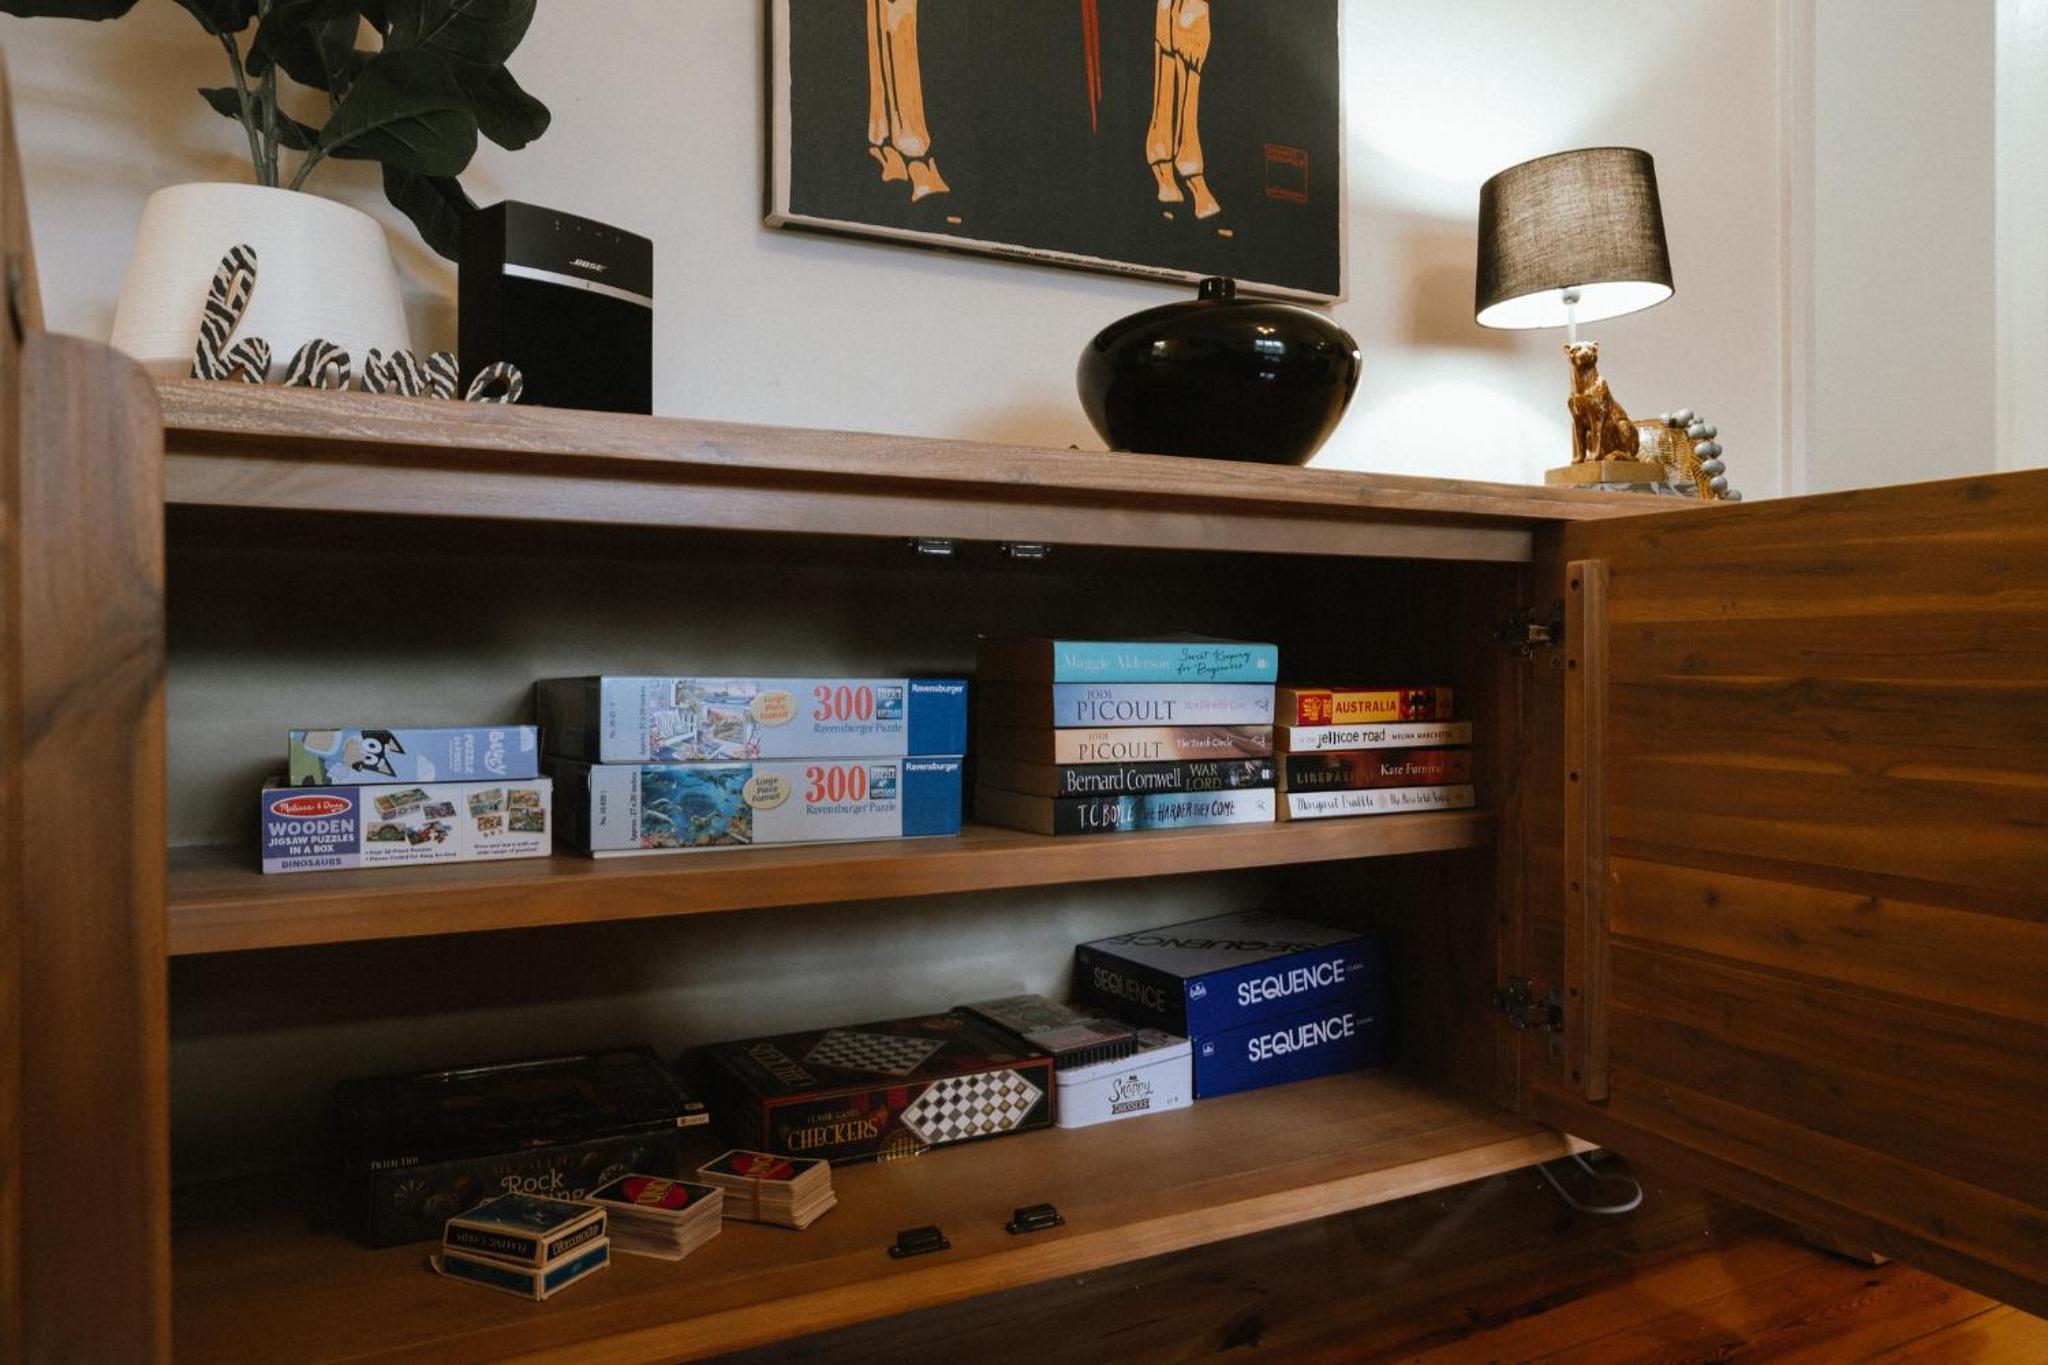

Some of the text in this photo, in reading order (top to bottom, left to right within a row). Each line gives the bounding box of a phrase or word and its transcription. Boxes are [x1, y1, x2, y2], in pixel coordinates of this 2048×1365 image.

[1064, 654, 1170, 669] Maggie Alderson
[911, 683, 964, 695] Ravensburger
[1087, 688, 1112, 699] JODI
[813, 685, 873, 721] 300
[1077, 700, 1176, 721] PICOULT
[1335, 700, 1397, 713] AUSTRALIA
[814, 722, 902, 735] Ravensburger Puzzle
[1316, 730, 1359, 748] jellicoe
[1362, 728, 1386, 743] road
[1079, 742, 1164, 761] PICOULT
[905, 762, 959, 773] Ravensburger
[1190, 763, 1218, 777] WAR
[1380, 764, 1403, 776] Kate
[805, 765, 866, 803] 300
[1067, 768, 1181, 792] Bernard Cornwell
[1186, 777, 1222, 790] LORD
[806, 802, 896, 815] Ravensburger Puzzle
[1102, 802, 1134, 824] BOYLE
[1157, 803, 1192, 823] HARDER
[1211, 801, 1235, 817] COME
[1297, 796, 1339, 813] Margaret
[268, 818, 354, 836] WOODEN
[268, 833, 355, 847] JIGSAW PUZZLES
[289, 844, 334, 855] IN A BOX
[281, 857, 342, 869] DINOSAURS
[1094, 967, 1166, 1012] SEQUENCE
[1237, 959, 1345, 1006] SEQUENCE
[1248, 1013, 1355, 1062] SEQUENCE
[787, 1116, 878, 1151] CHECKERS
[500, 1167, 564, 1193] Rock
